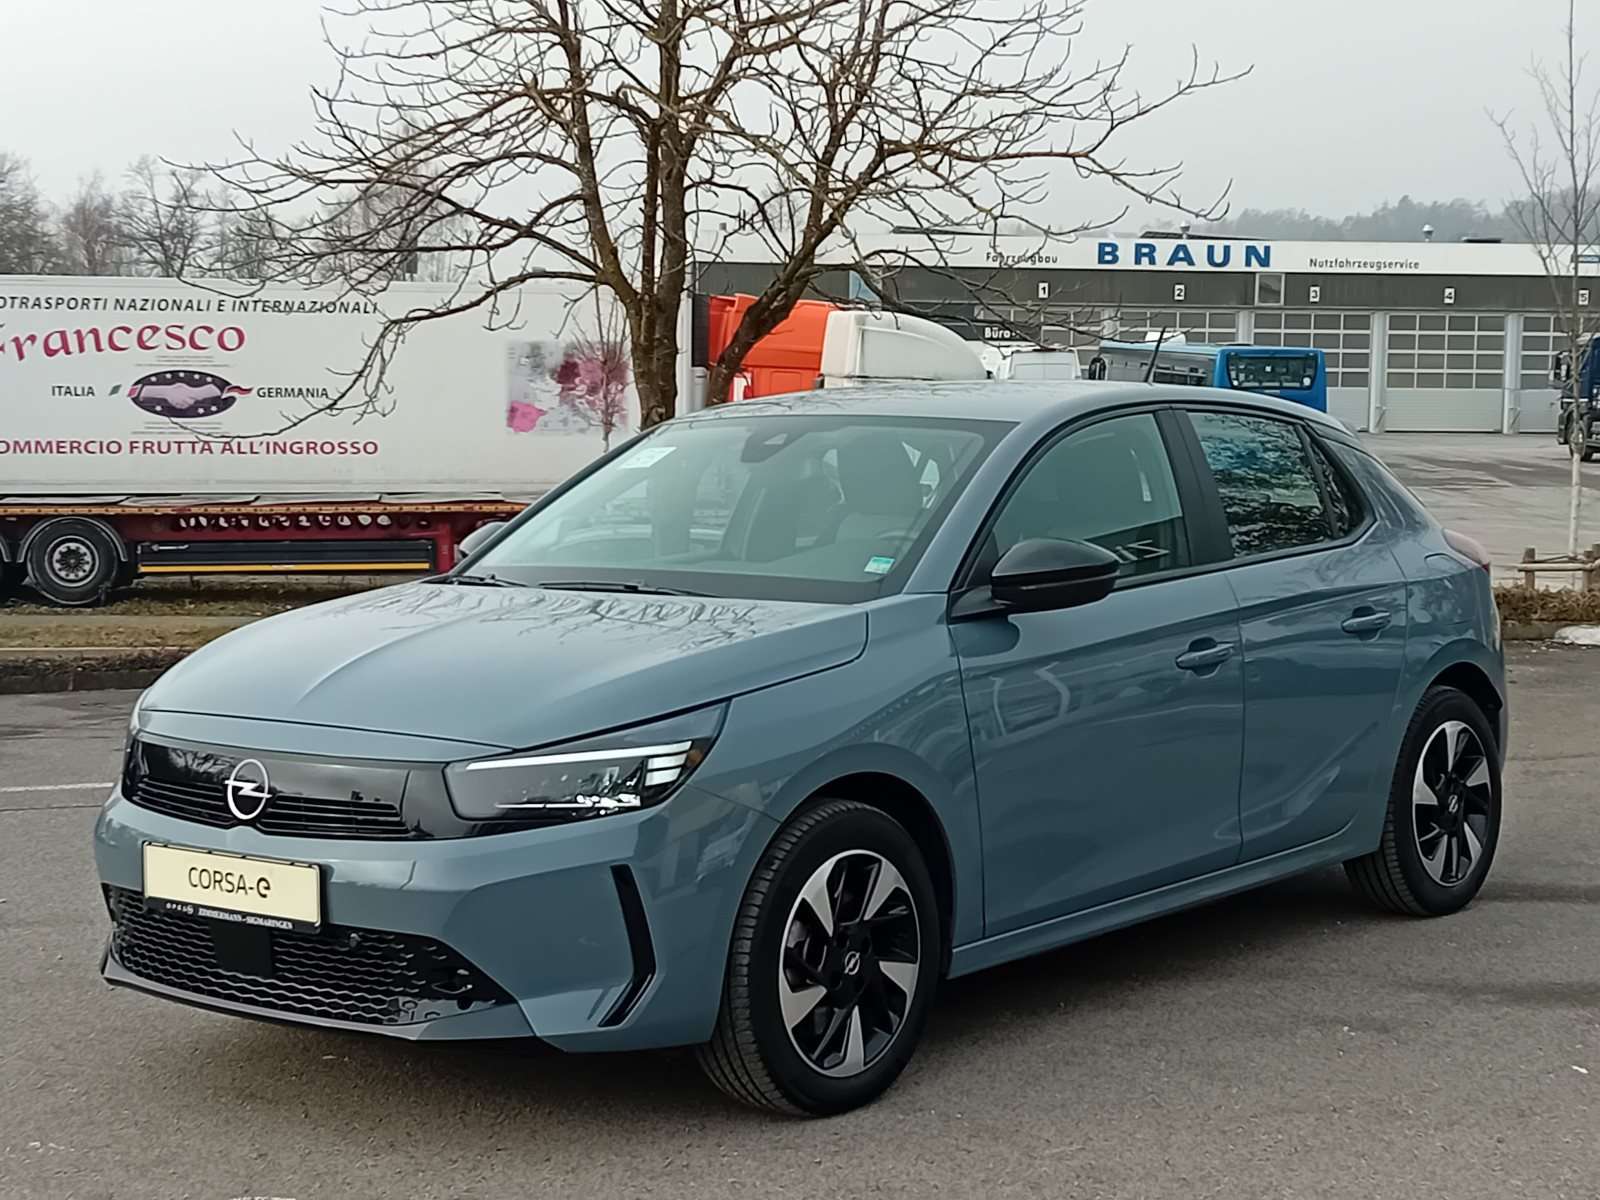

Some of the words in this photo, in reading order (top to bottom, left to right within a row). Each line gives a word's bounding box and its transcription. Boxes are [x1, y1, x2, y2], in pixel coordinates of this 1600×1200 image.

[1097, 242, 1271, 268] BRAUN
[1309, 258, 1420, 270] Nutzfahrzeugservice
[113, 298, 211, 312] NAZIONALI
[217, 300, 226, 311] E
[231, 300, 377, 314] INTERNAZIONALI
[0, 323, 246, 361] rancesco
[51, 385, 95, 397] ITALIA
[256, 387, 328, 399] GERMANIA
[129, 440, 213, 455] FRUTTA
